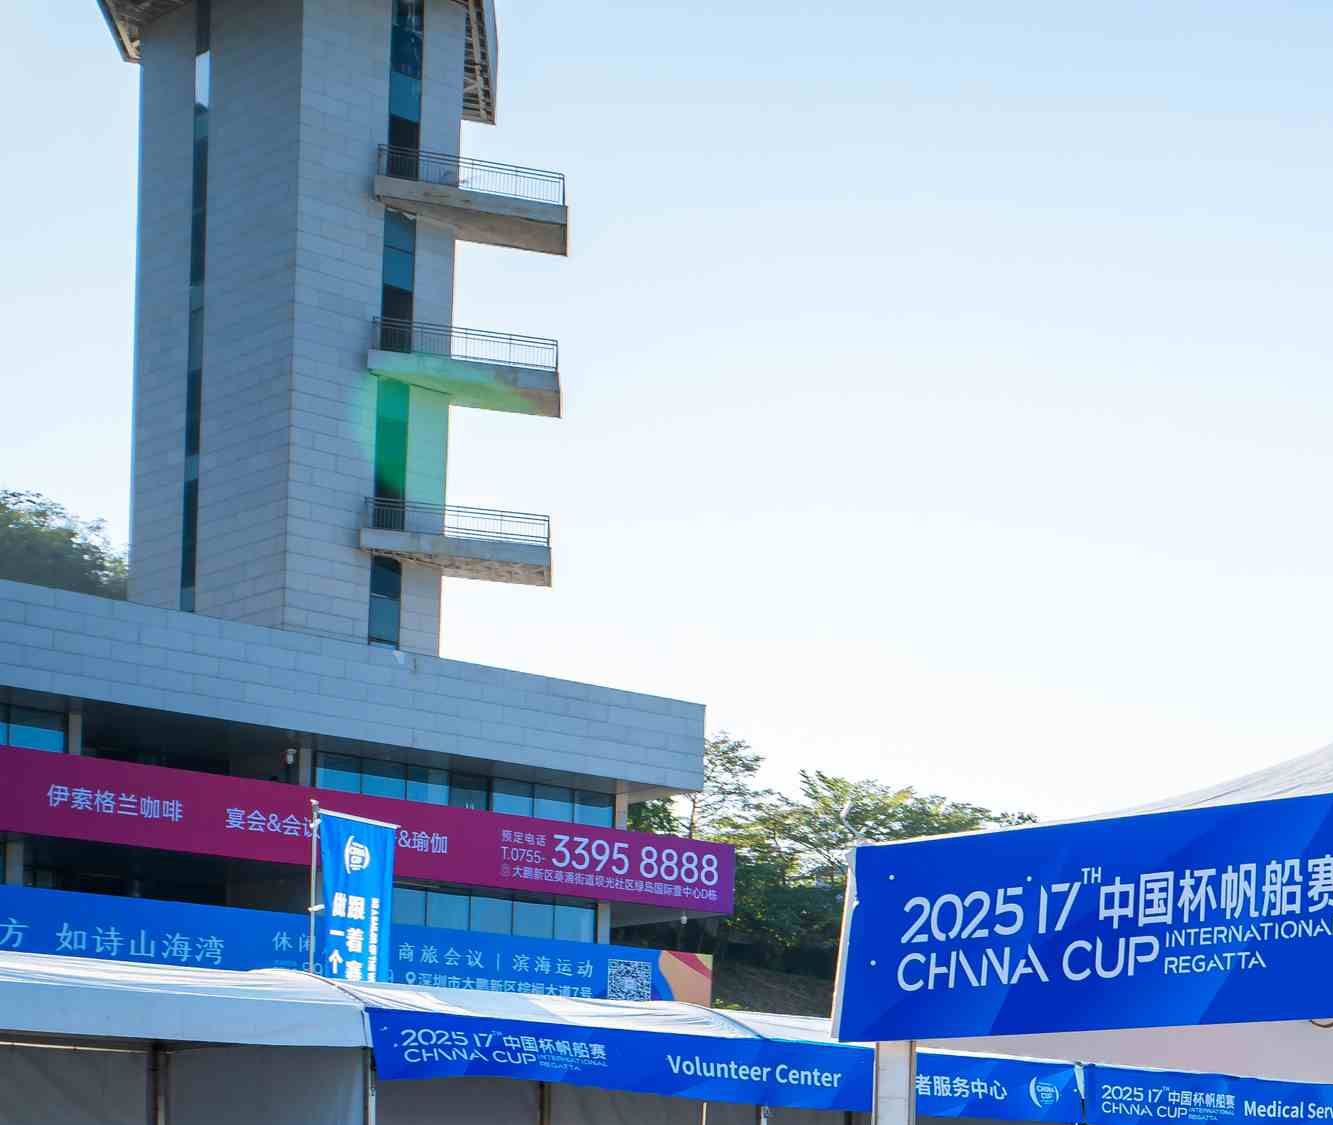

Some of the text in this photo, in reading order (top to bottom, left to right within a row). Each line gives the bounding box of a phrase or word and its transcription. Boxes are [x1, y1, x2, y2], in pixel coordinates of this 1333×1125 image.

[47, 784, 184, 822] 伊索格兰咖啡
[552, 834, 718, 886] 3395 8888
[900, 887, 1024, 944] 2025
[56, 922, 224, 965] 如诗山海湾
[399, 942, 485, 969] 商旅会议
[512, 953, 594, 978] 滨海运动
[897, 934, 1160, 992] CHINA CUP
[1164, 949, 1267, 976] REGATTA
[400, 1028, 467, 1047] 2025
[502, 1034, 608, 1060] 中国杯帆船赛
[403, 1047, 489, 1064] CHINA
[492, 1050, 537, 1065] CUP
[666, 1054, 842, 1088] Volunteer Center
[1102, 1084, 1144, 1101] 2025
[1168, 1089, 1236, 1109] 中国杯帆船赛
[1102, 1101, 1153, 1117] CHINA
[1156, 1106, 1188, 1119] CUP
[1244, 1100, 1304, 1119] Medical
